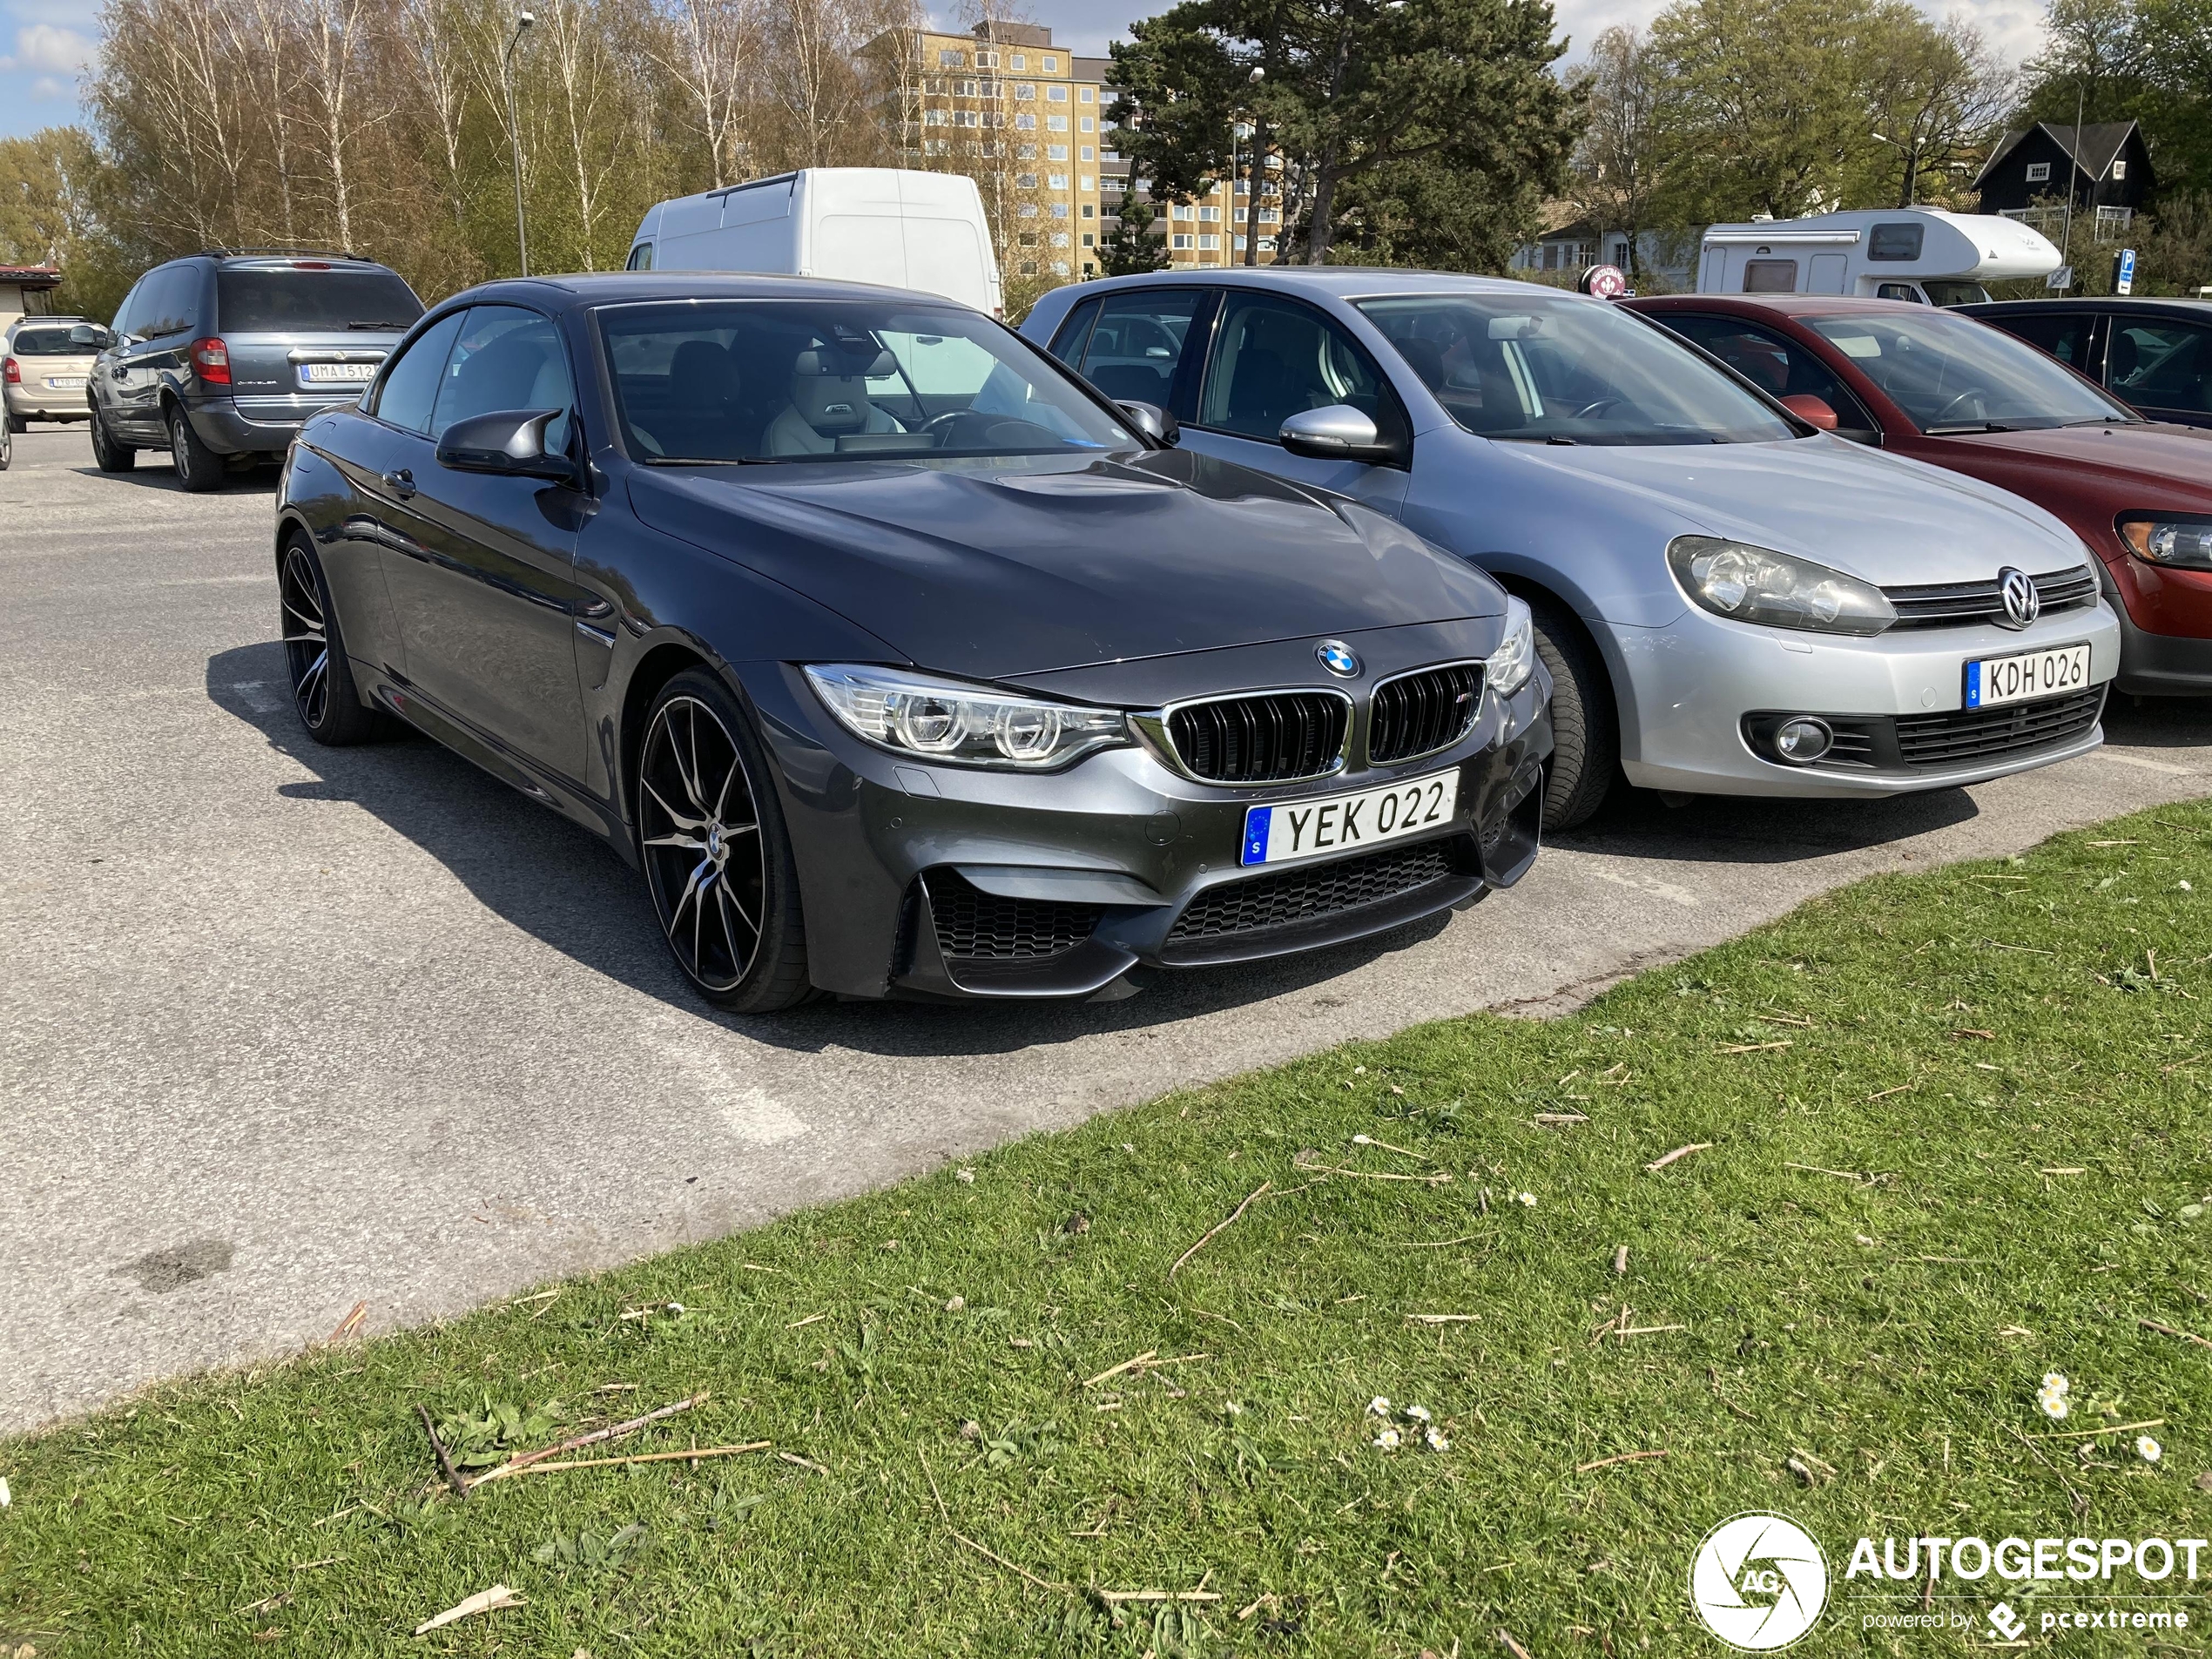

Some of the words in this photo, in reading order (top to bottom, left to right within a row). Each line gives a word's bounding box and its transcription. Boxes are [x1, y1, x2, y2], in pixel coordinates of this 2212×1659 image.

[2124, 252, 2133, 270] P
[310, 365, 338, 378] UMA
[347, 365, 374, 377] 512
[1971, 689, 1977, 699] S
[1990, 658, 2035, 698] KDH
[2043, 650, 2081, 689] 026
[1251, 841, 1261, 854] S
[1288, 798, 1366, 852] YEK
[1378, 780, 1444, 833] 022
